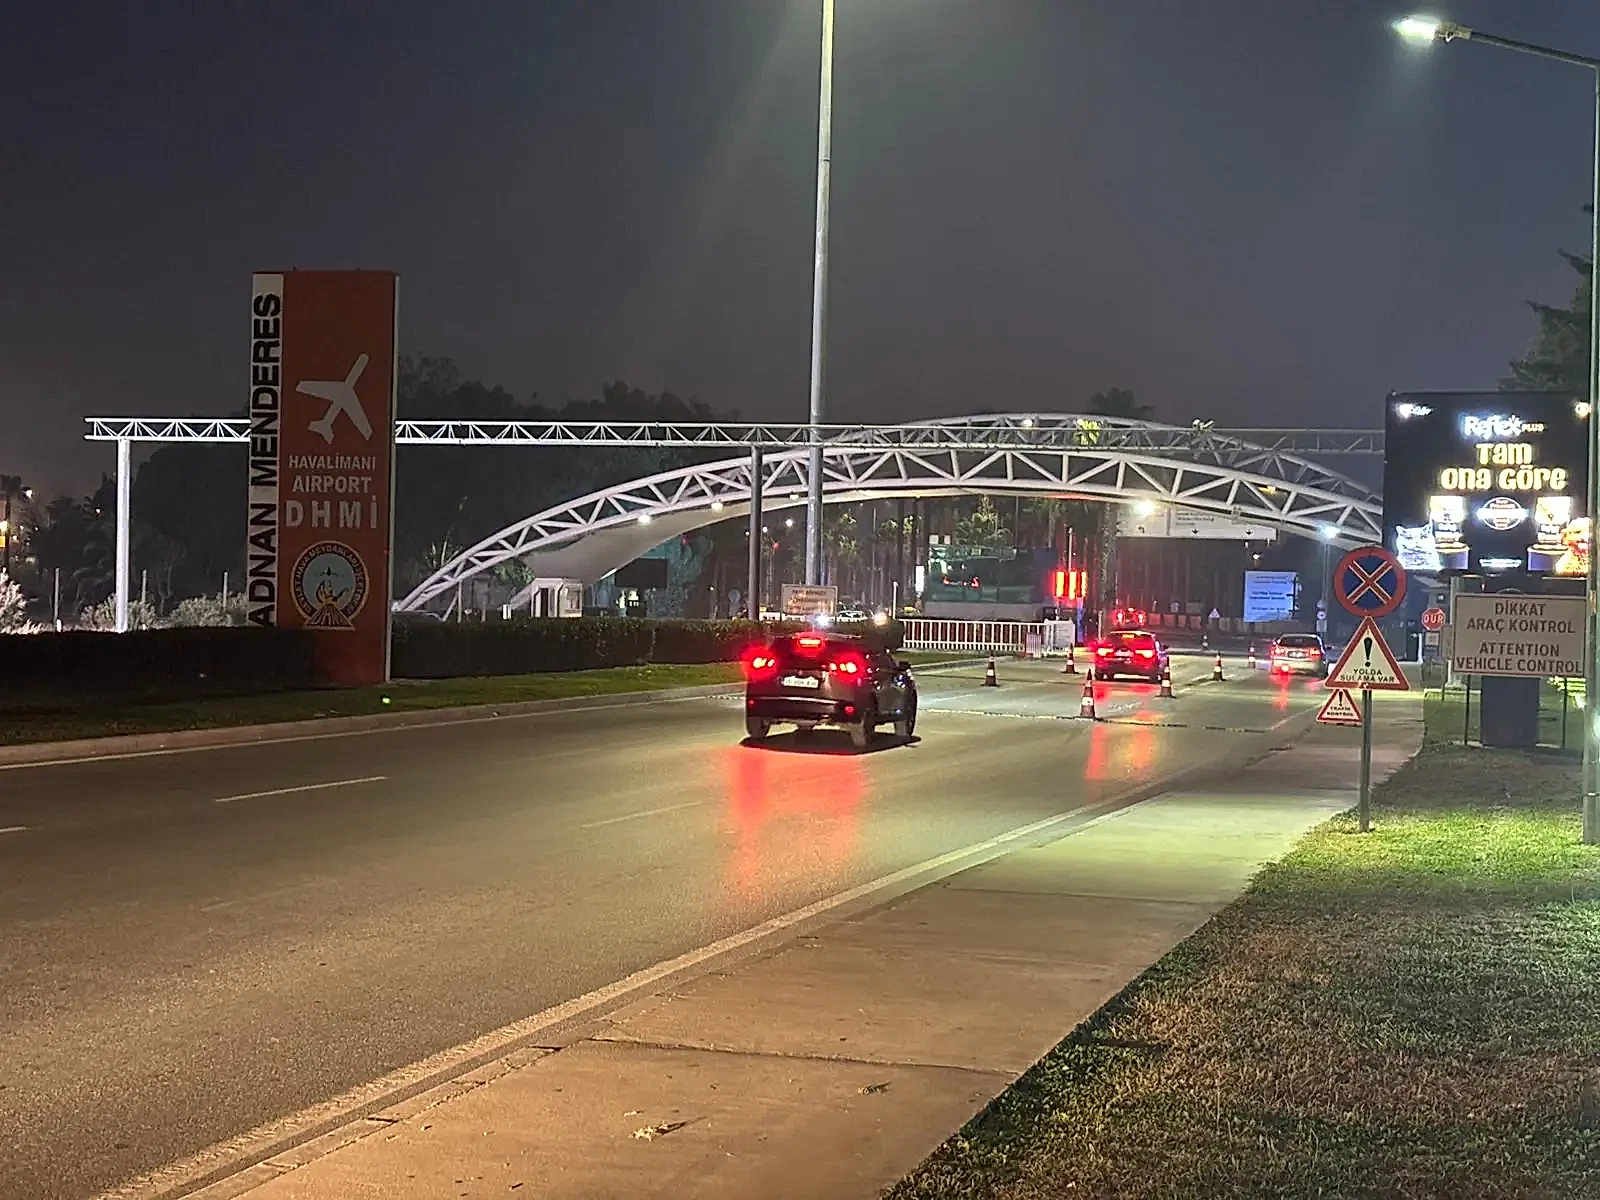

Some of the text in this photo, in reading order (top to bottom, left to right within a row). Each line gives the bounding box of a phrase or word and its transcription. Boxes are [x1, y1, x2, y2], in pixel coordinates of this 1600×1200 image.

[248, 292, 282, 628] ADNAN MENDERES
[288, 452, 376, 471] HAVALİMANI
[291, 475, 372, 494] AIRPORT
[1495, 600, 1547, 616] DİKKAT
[1424, 613, 1444, 625] DUR
[1466, 617, 1577, 635] ARAÇ KONTROL
[1479, 641, 1560, 656] ATTENTION
[1353, 668, 1383, 676] YOLDA
[1456, 656, 1582, 674] VEHICLE CONTROL
